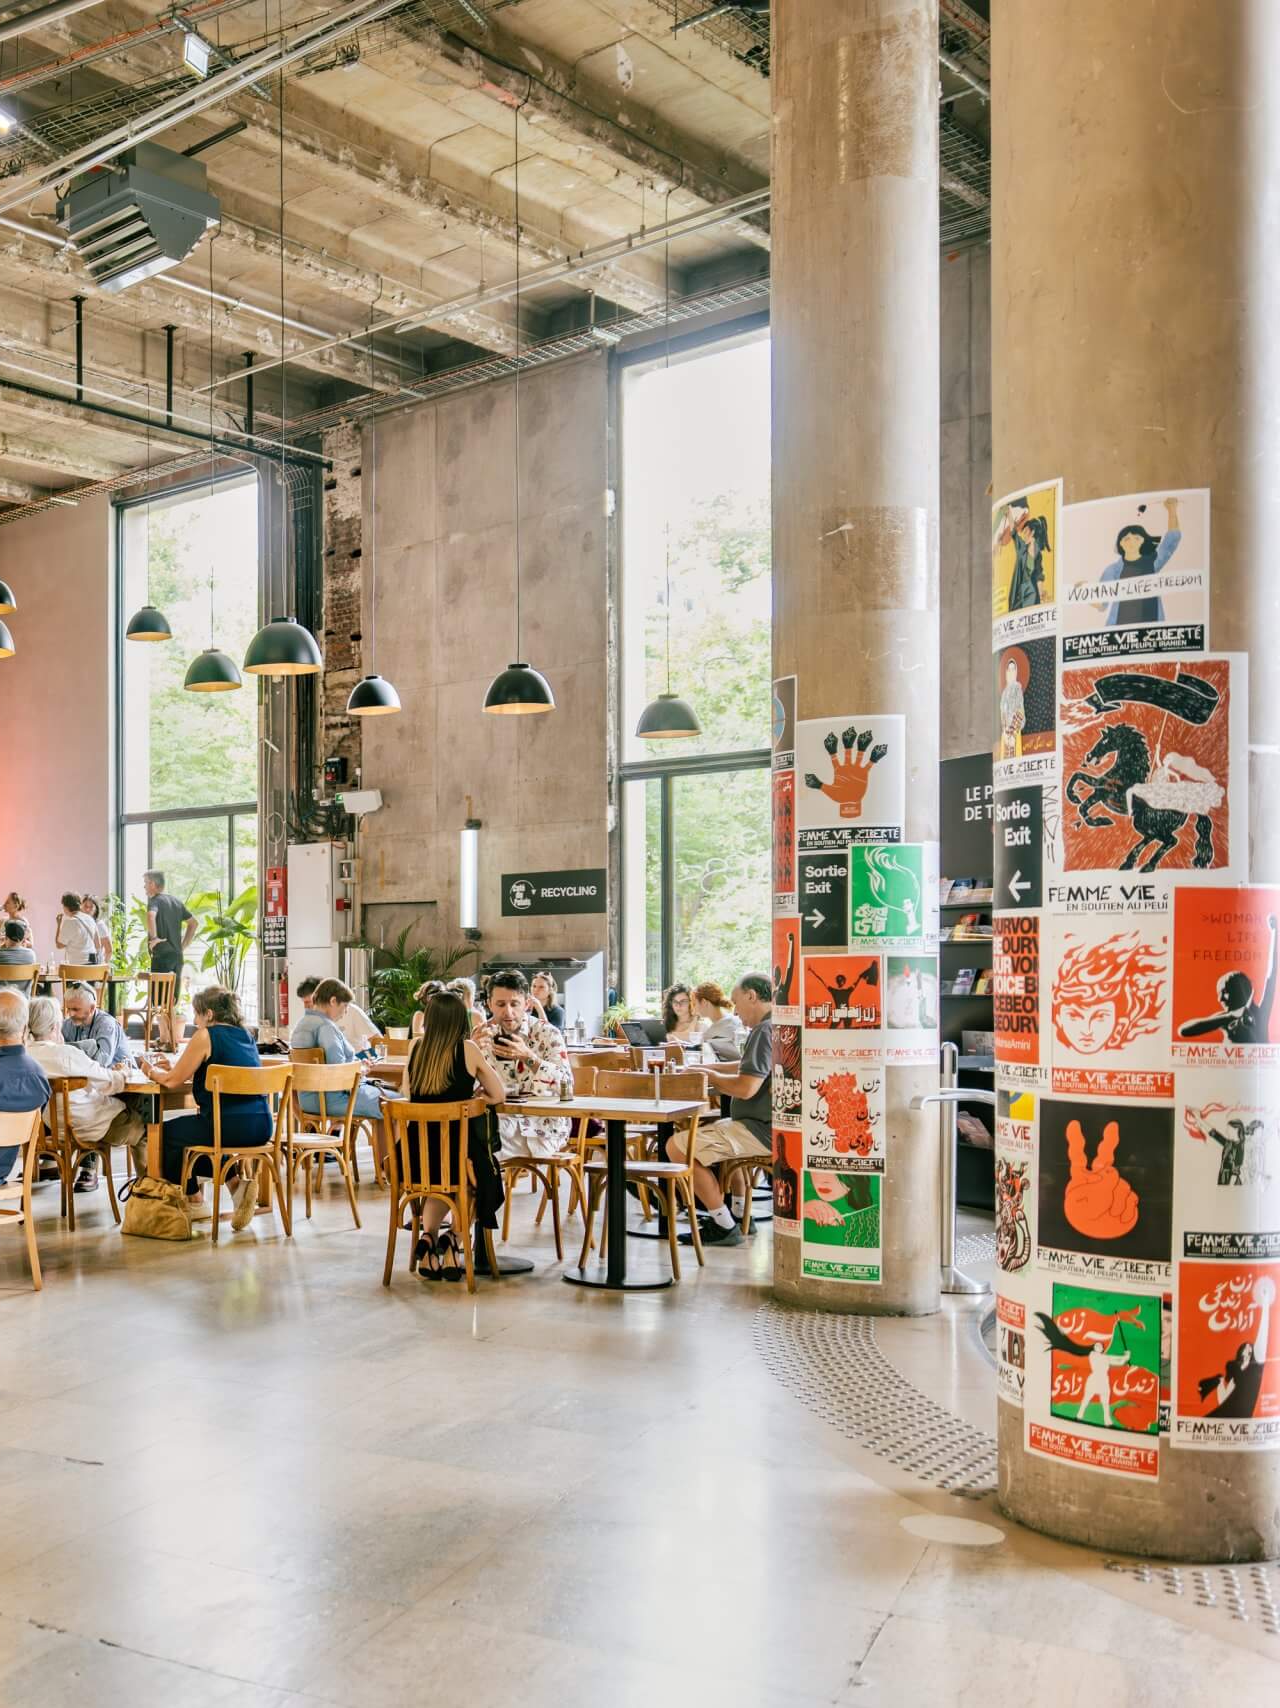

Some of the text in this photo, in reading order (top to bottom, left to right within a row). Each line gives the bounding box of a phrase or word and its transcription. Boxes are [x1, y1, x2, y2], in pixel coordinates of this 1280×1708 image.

[1068, 582, 1120, 600] WOMAN
[1127, 580, 1152, 595] LIFE
[1065, 626, 1201, 651] FEMME VIE LIBERTÉ
[1078, 639, 1187, 655] EN SOUTIEN AU PEUPLE IRANIEN
[966, 785, 993, 802] LE P
[964, 806, 982, 821] DE
[996, 800, 1031, 822] Sortie
[799, 827, 900, 841] FEMME VIE LIBERTÉ
[1004, 826, 1032, 847] Exit
[805, 864, 848, 878] Sortie
[540, 886, 598, 898] RECYCLING
[805, 881, 832, 894] Exit
[1048, 885, 1155, 903] FEMME VIE
[1066, 903, 1079, 911] EN
[1081, 902, 1124, 911] SOUTIEN
[1127, 902, 1141, 910] AU
[1171, 1046, 1245, 1058] FEMME VIE
[1085, 1072, 1108, 1083] VIE
[1113, 1073, 1172, 1087] LIBERTÉ
[1011, 1125, 1031, 1141] VIE
[1186, 1234, 1254, 1247] FEMME VIE
[1037, 1248, 1077, 1264] FEMME
[1081, 1256, 1105, 1269] VIE
[1230, 1273, 1253, 1293] زن
[1198, 1280, 1241, 1312] زندگی
[1057, 1311, 1086, 1335] زن
[1208, 1303, 1258, 1332] آزادی
[1112, 1366, 1156, 1396] زندگی
[1177, 1421, 1248, 1434] FEMME VIE
[1031, 1426, 1155, 1464] FEMME VIE LIBERTÉ
